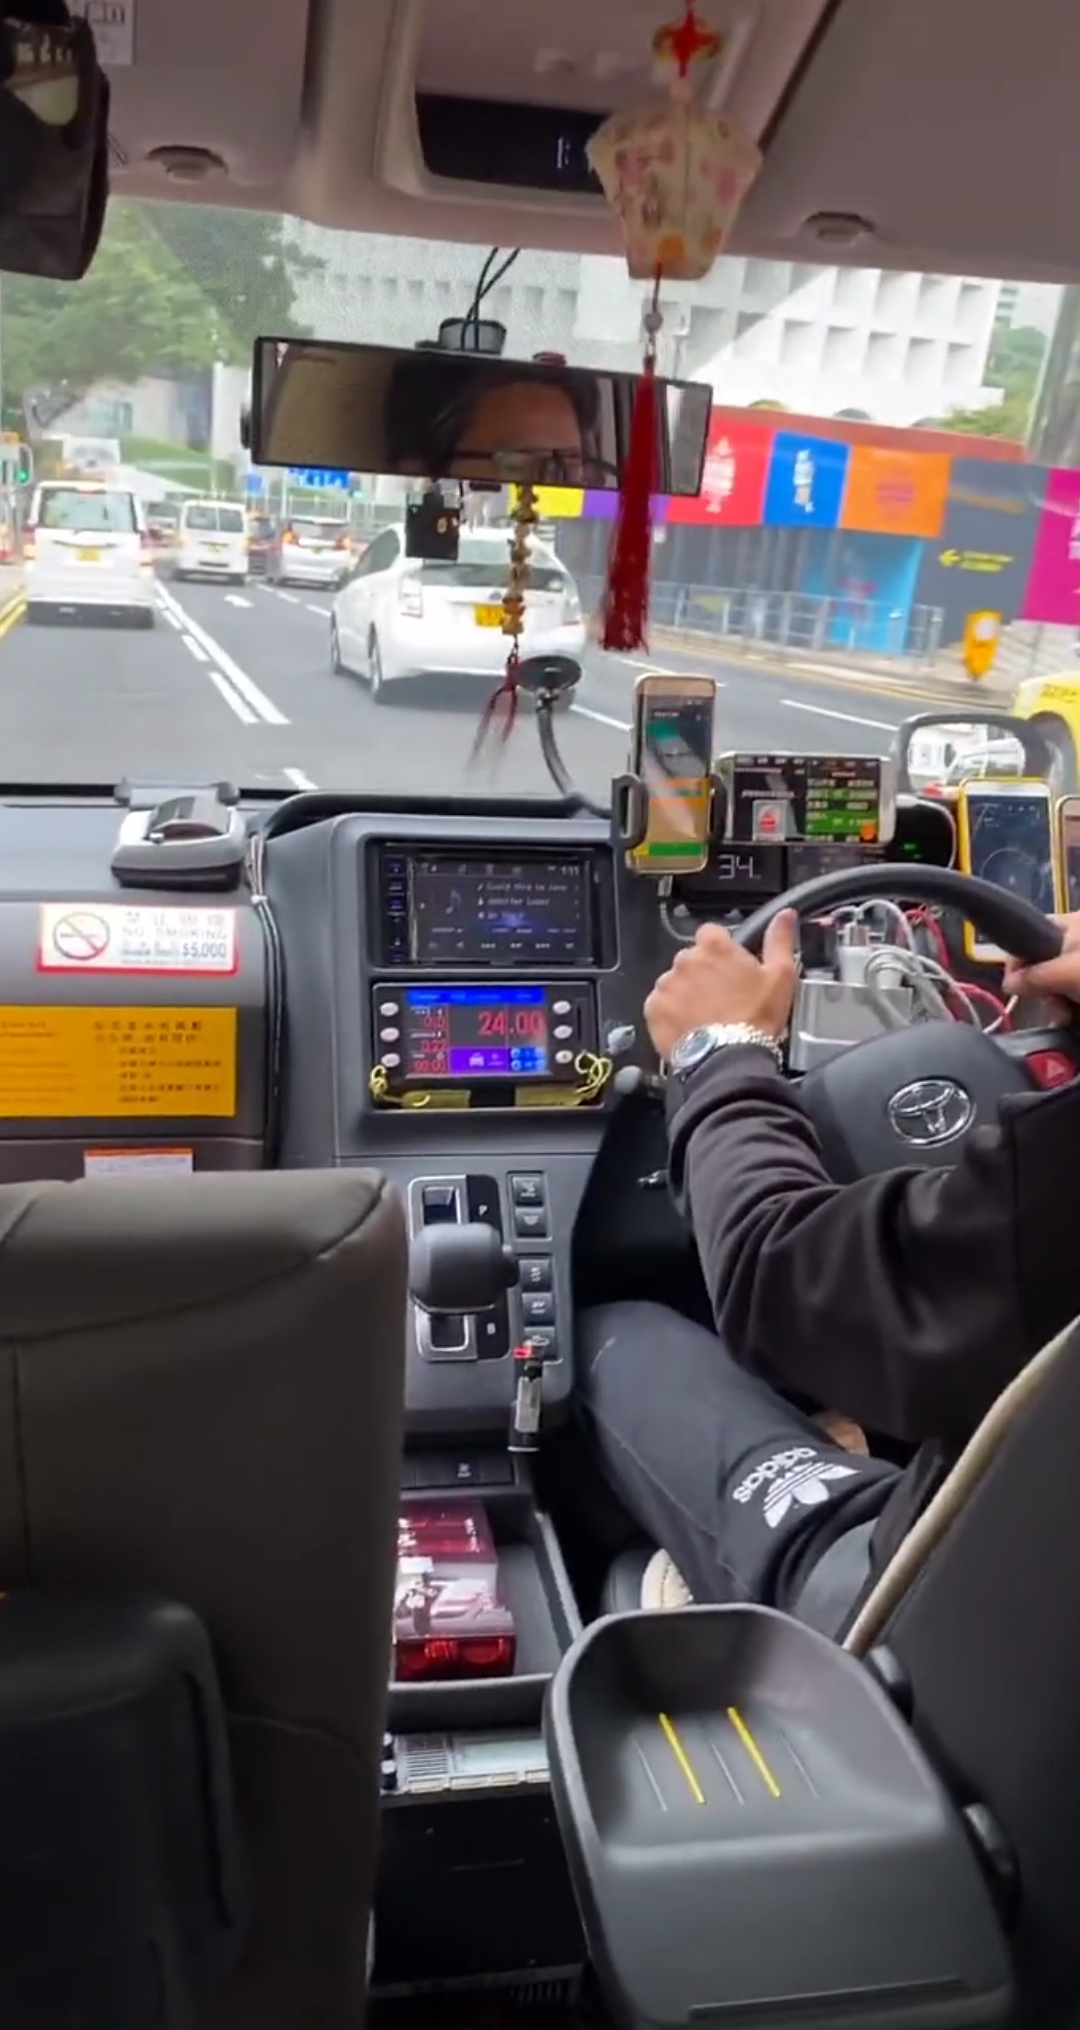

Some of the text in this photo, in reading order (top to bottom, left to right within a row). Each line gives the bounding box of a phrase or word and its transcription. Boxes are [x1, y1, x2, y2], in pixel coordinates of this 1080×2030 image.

[717, 854, 754, 880] 34
[182, 941, 227, 959] $5,000
[478, 1010, 544, 1036] 24.00
[478, 1204, 488, 1216] P
[732, 1446, 818, 1504] adidas
